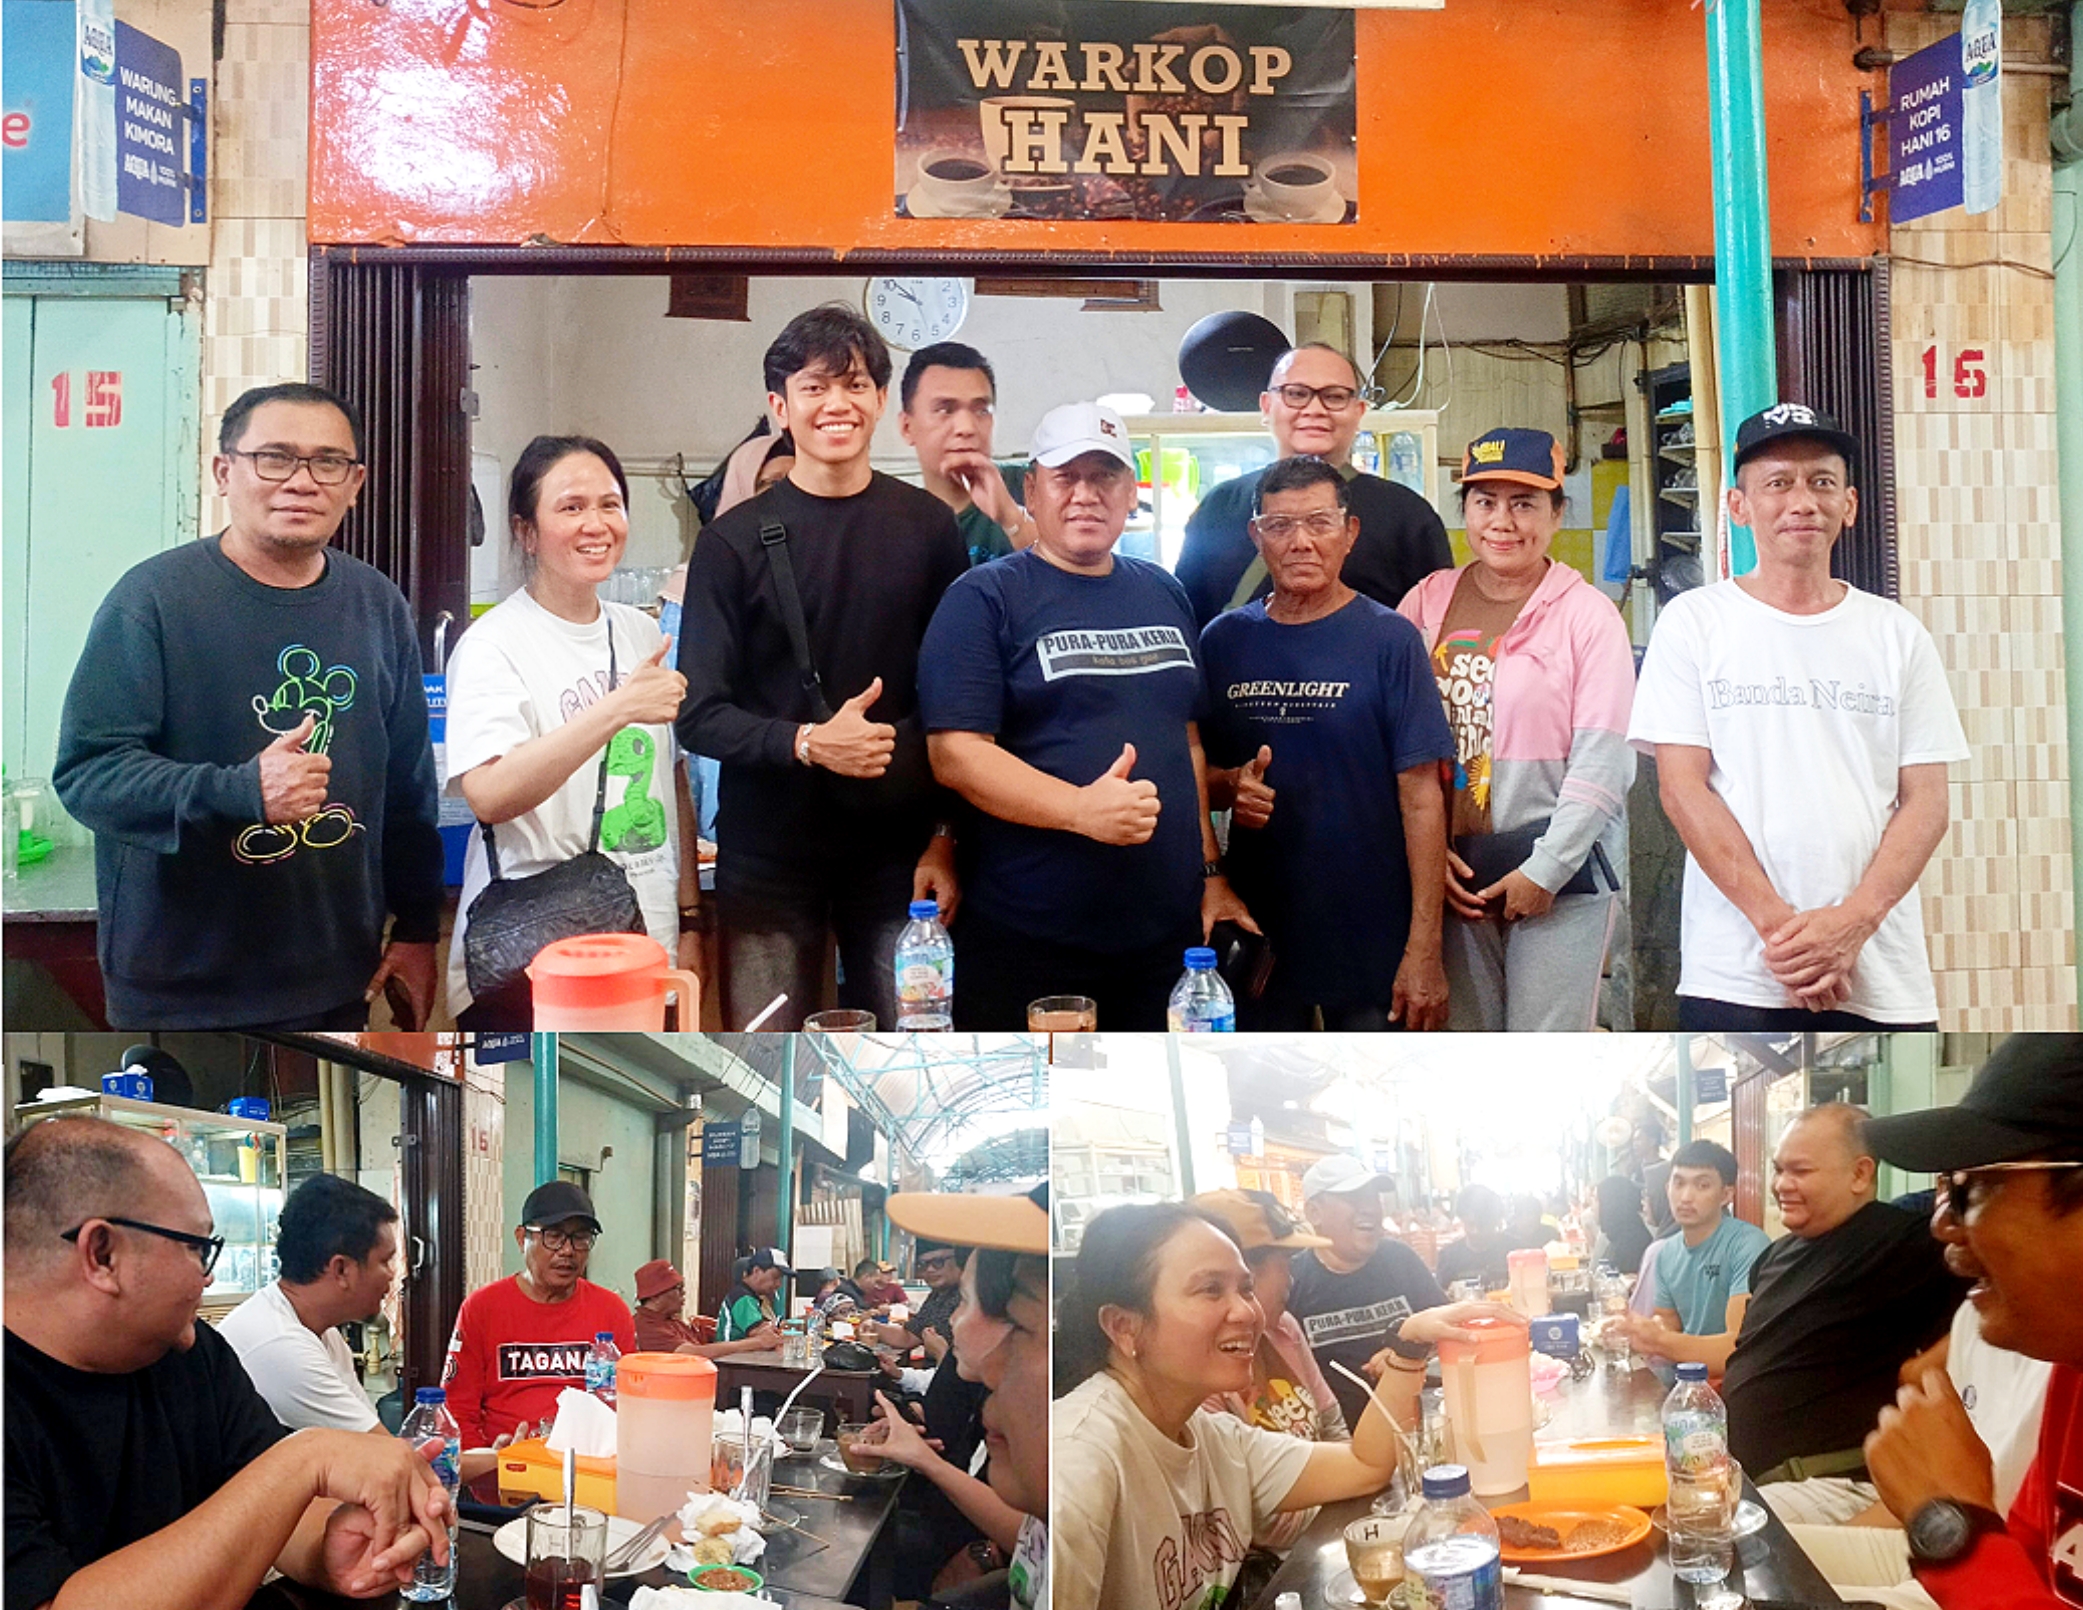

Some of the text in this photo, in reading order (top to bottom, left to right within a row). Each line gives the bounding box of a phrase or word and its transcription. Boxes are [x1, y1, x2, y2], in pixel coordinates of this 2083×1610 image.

[957, 39, 1293, 95] WARKOP
[119, 66, 178, 107] WARUNG
[1900, 76, 1950, 112] RUMAH
[125, 95, 173, 130] MAKAN
[1909, 104, 1942, 132] KOPI
[124, 121, 176, 156] KIMORA
[1002, 110, 1249, 177] HANI
[1901, 123, 1951, 158] HANI 16
[942, 280, 951, 292] 2
[877, 294, 887, 306] 9
[948, 296, 957, 308] 3
[881, 310, 891, 324] 8
[896, 323, 905, 336] 7
[931, 324, 940, 337] 5
[911, 329, 921, 342] 6
[1921, 344, 1986, 399] 16
[52, 371, 122, 427] 15
[1043, 632, 1141, 654] PURA-PURA
[1226, 680, 1351, 700] GREENLIGHT
[1707, 675, 1896, 718] Banda Neira
[471, 1125, 488, 1152] 16
[1308, 1307, 1376, 1333] PURA-PURA
[1363, 1523, 1380, 1541] H
